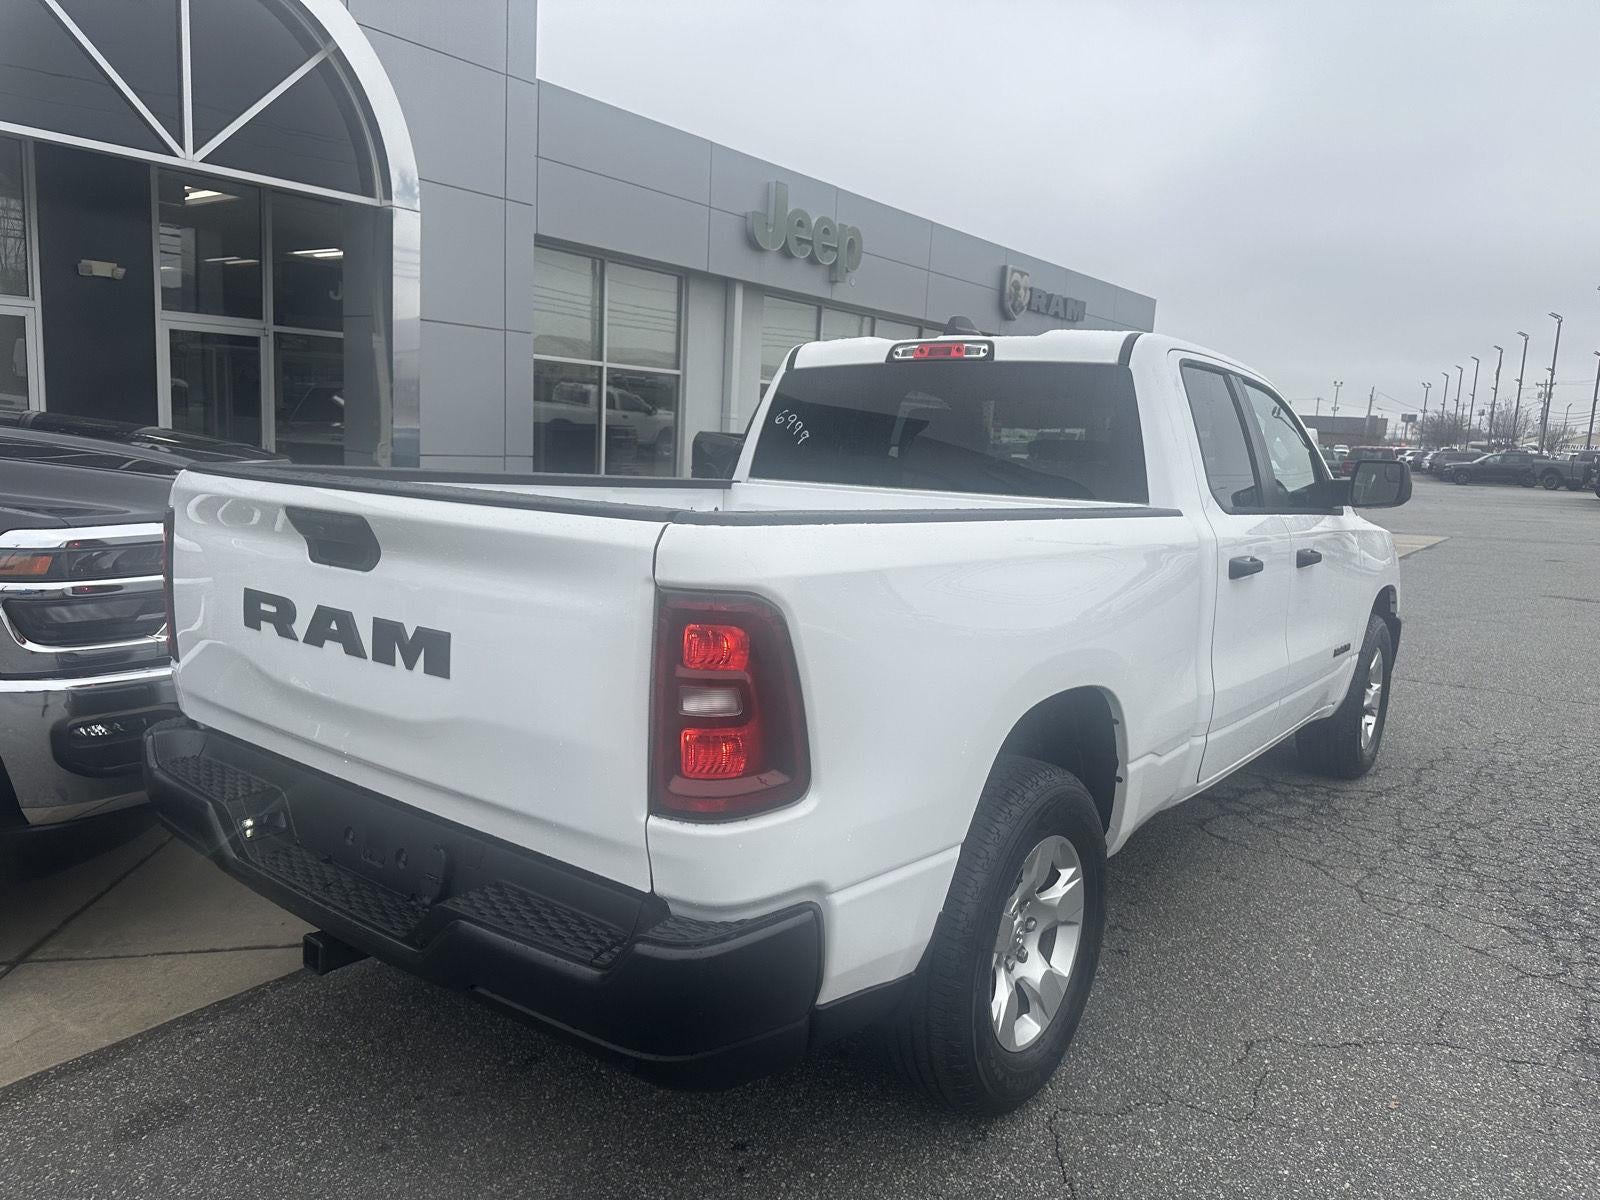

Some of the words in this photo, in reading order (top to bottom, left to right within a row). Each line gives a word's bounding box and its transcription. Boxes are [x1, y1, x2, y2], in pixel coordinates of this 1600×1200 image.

[746, 180, 862, 283] Jeep
[1028, 287, 1086, 322] RAM
[243, 587, 451, 680] RAM
